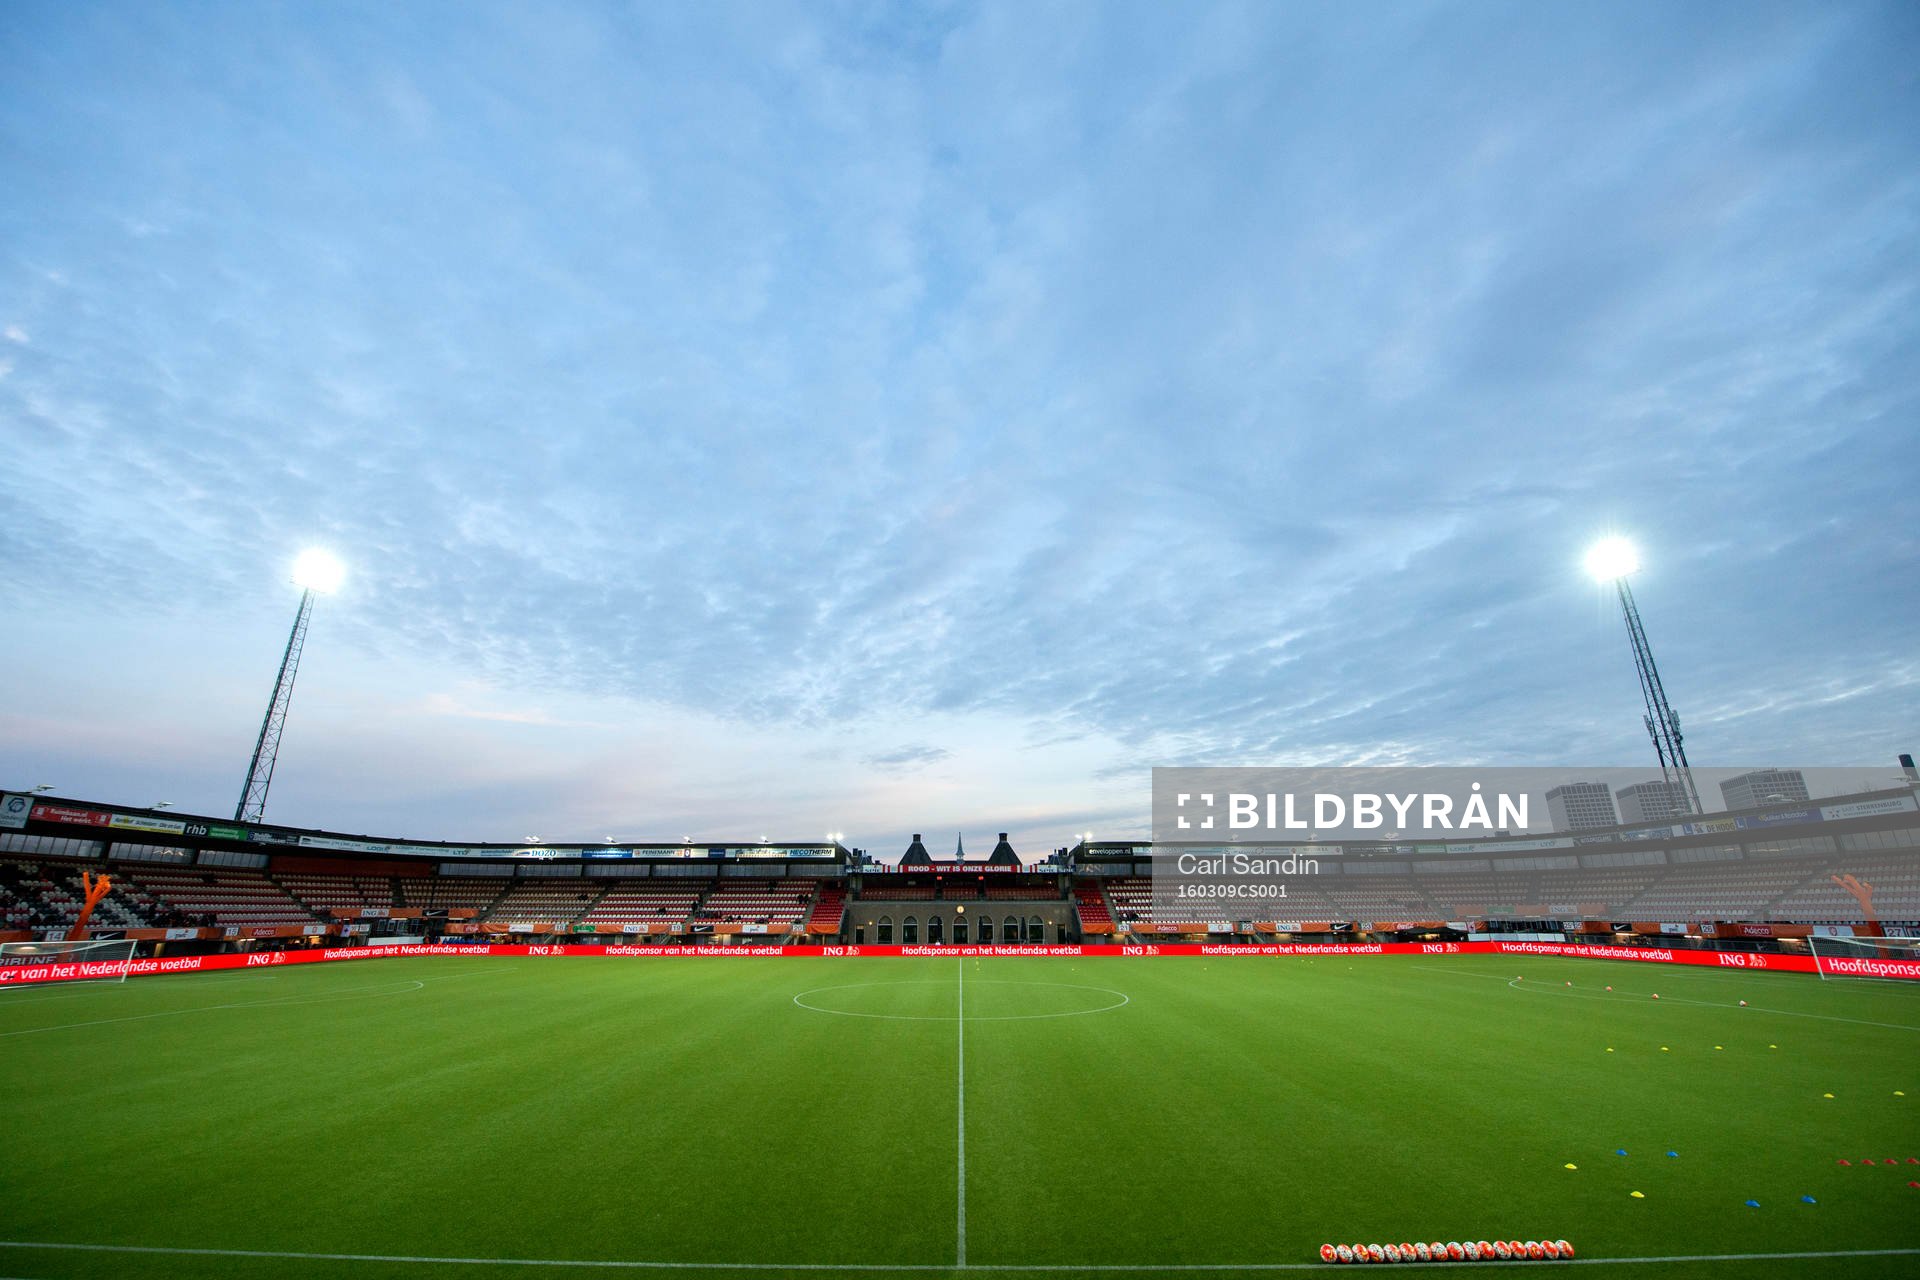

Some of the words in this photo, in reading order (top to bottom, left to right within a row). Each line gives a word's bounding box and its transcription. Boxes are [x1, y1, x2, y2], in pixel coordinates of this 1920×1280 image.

[186, 824, 207, 836] rhb
[253, 928, 275, 936] Adecco
[1887, 928, 1901, 937] 27
[324, 947, 371, 959] Hoofdsponsor
[384, 946, 398, 954] het
[400, 945, 457, 954] Nederlandse
[459, 945, 490, 954] voetbal
[528, 946, 548, 955] ING
[605, 946, 663, 957] Hoofdsponsor
[664, 946, 680, 955] van
[681, 946, 695, 955] het
[697, 946, 750, 955] Nederlandse
[751, 946, 782, 955] voetbal
[823, 947, 843, 955] ING
[902, 946, 960, 956] Hoofdsponsor
[962, 946, 976, 955] van
[979, 946, 993, 955] het
[995, 946, 1048, 955] Nederlandse
[1049, 946, 1081, 955] voetbal
[1122, 946, 1142, 955] ING
[1202, 945, 1260, 956] Hoofdsponsor
[1261, 945, 1278, 954] van
[1279, 945, 1293, 954] het
[1295, 945, 1349, 954] Nederlandse
[1350, 945, 1382, 954] voetbal
[1422, 944, 1443, 953] ING
[1502, 942, 1561, 954] Hoofdsponsor
[1562, 945, 1576, 954] van
[1577, 945, 1589, 955] het
[1590, 947, 1638, 958] Nederlandse
[1640, 949, 1673, 960] voetbal
[247, 954, 269, 965] ING
[1718, 953, 1745, 966] ING
[21, 968, 48, 979] van
[50, 964, 76, 977] het
[79, 959, 157, 976] Nederlandse
[160, 957, 201, 971] voetbal
